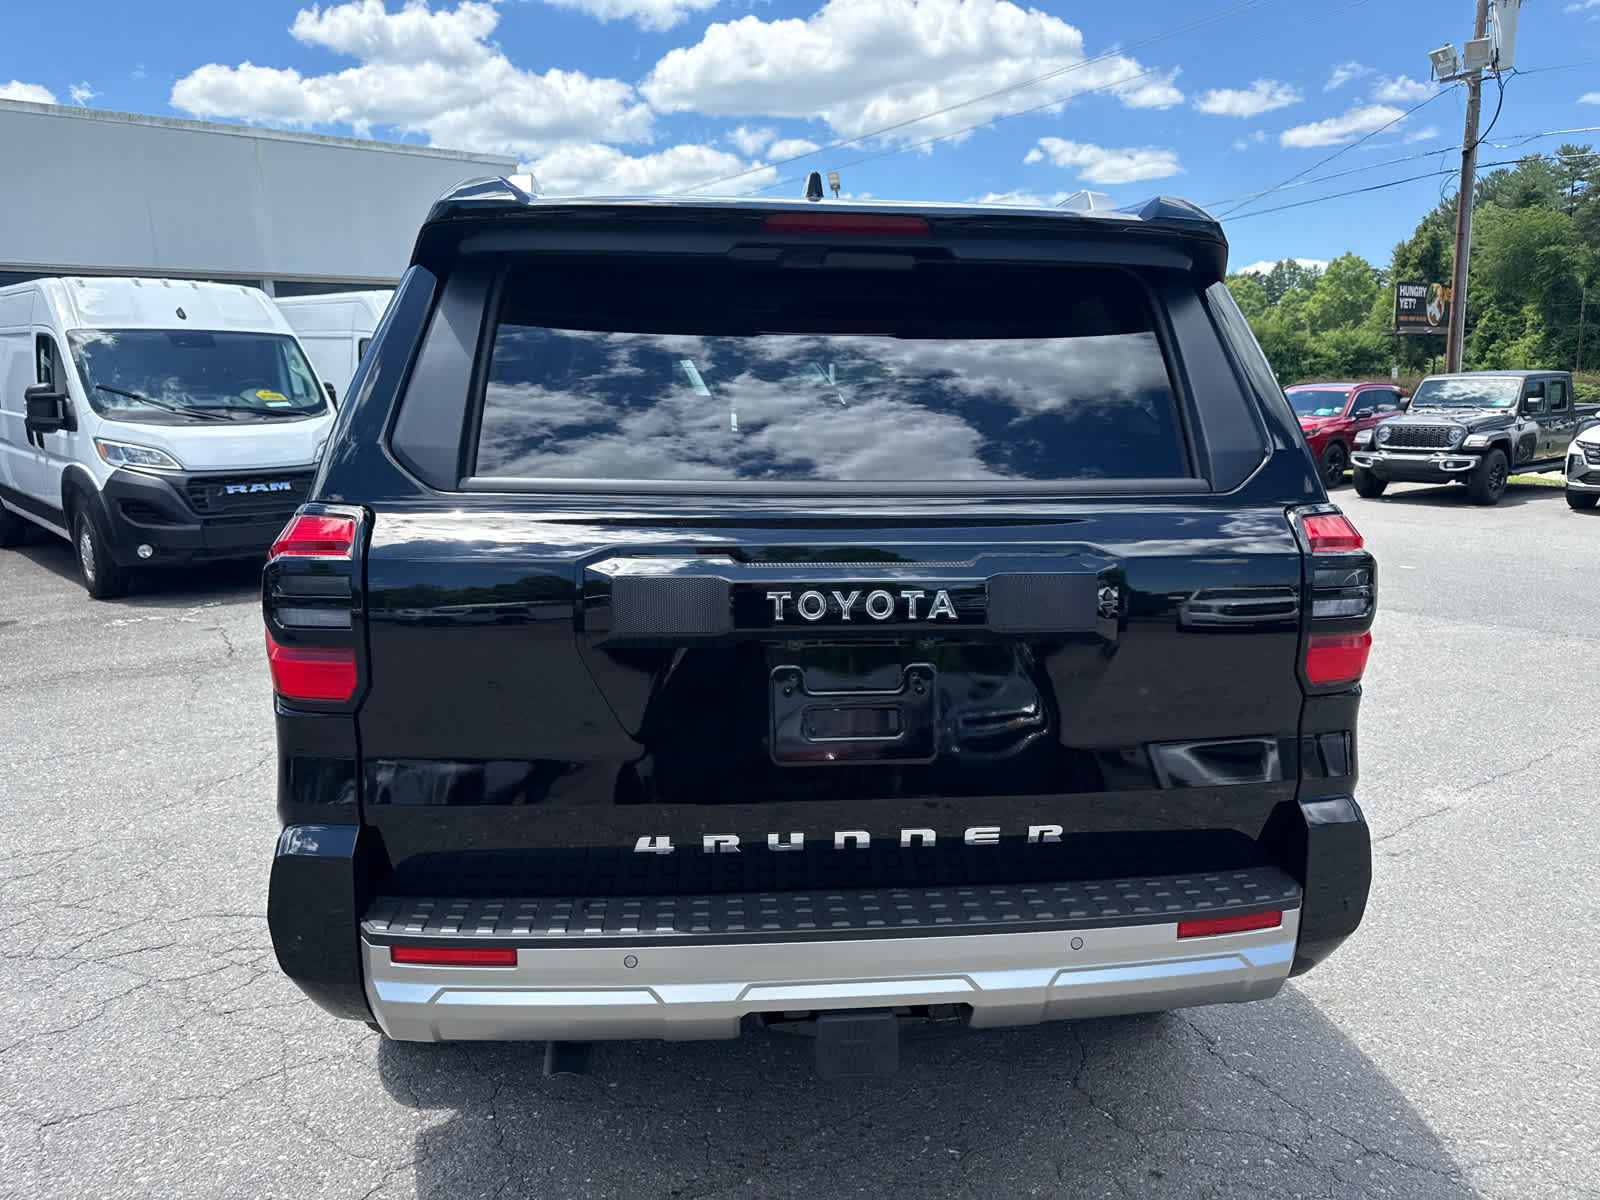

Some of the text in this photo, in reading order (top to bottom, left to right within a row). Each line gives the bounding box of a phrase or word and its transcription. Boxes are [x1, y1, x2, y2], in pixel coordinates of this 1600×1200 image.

[1399, 285, 1427, 298] HUNGRY
[1399, 298, 1417, 309] YET?
[225, 482, 292, 495] RAM
[766, 589, 959, 621] TOYOTA
[633, 824, 1064, 855] 4RUNNER
